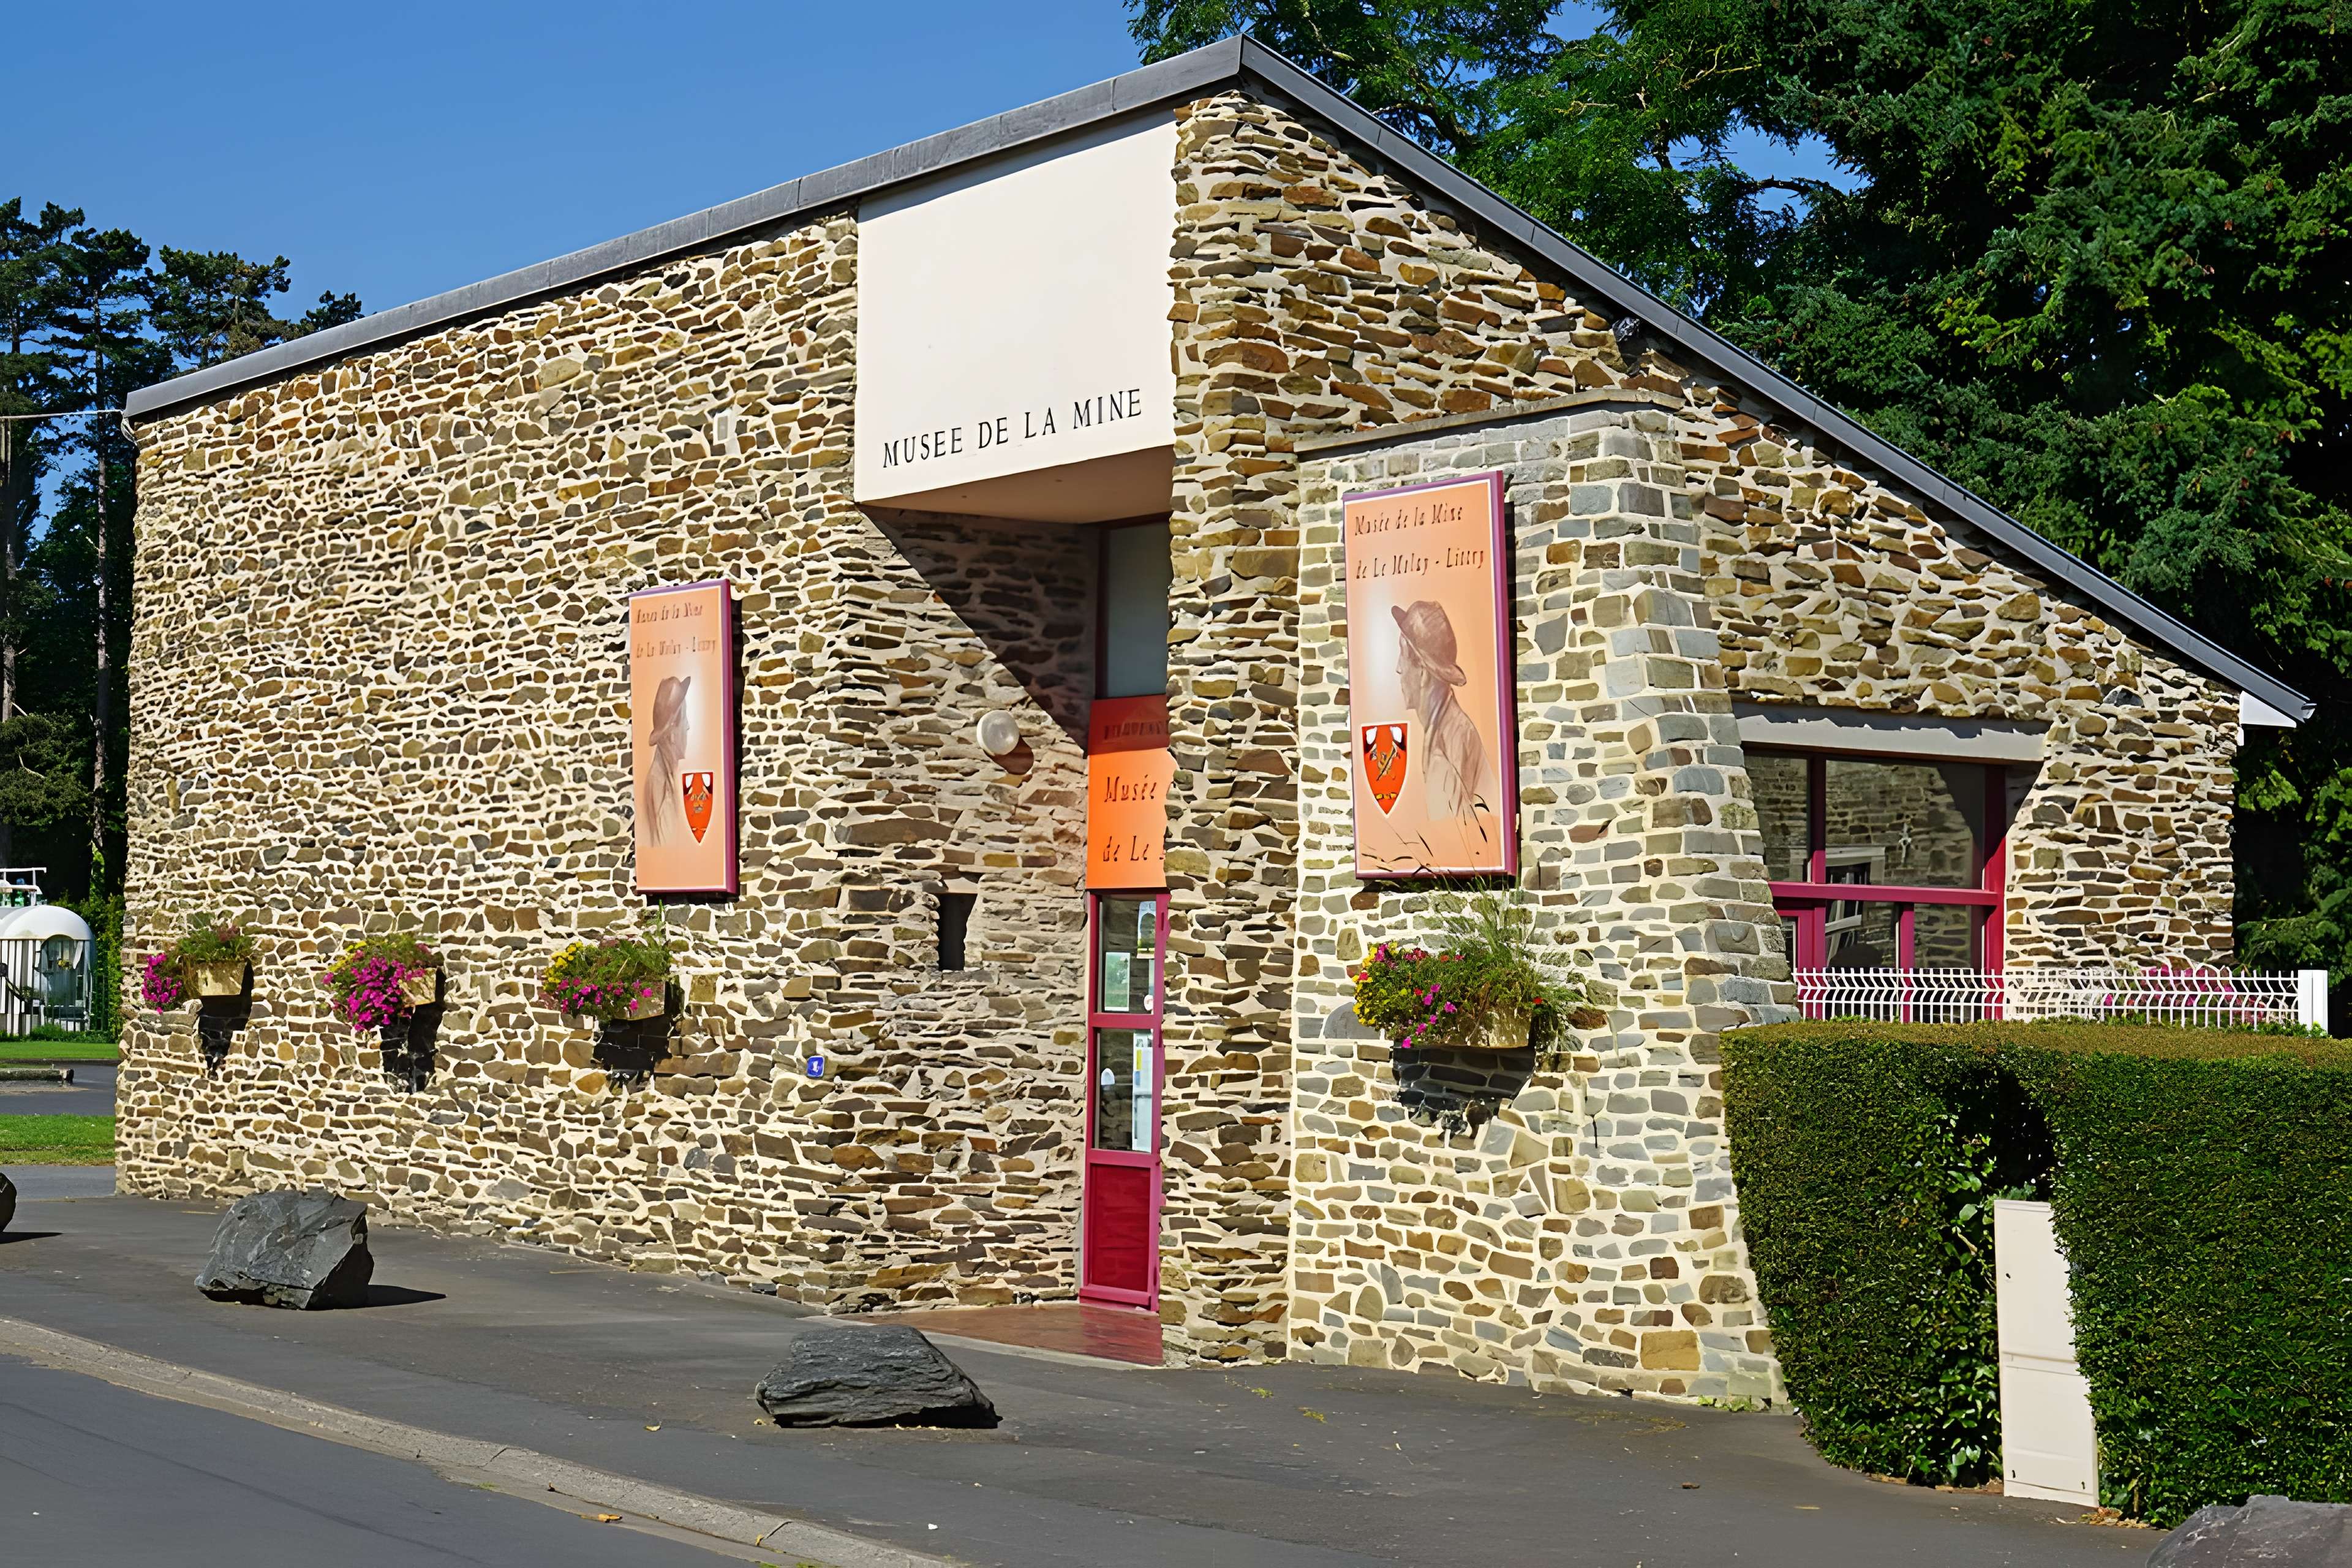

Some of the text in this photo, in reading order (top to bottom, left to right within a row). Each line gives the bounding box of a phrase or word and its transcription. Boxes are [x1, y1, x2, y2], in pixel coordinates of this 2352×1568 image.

[883, 388, 1142, 468] MUSEE DE LA MINE
[1104, 774, 1157, 802] Musée
[1102, 835, 1120, 862] de
